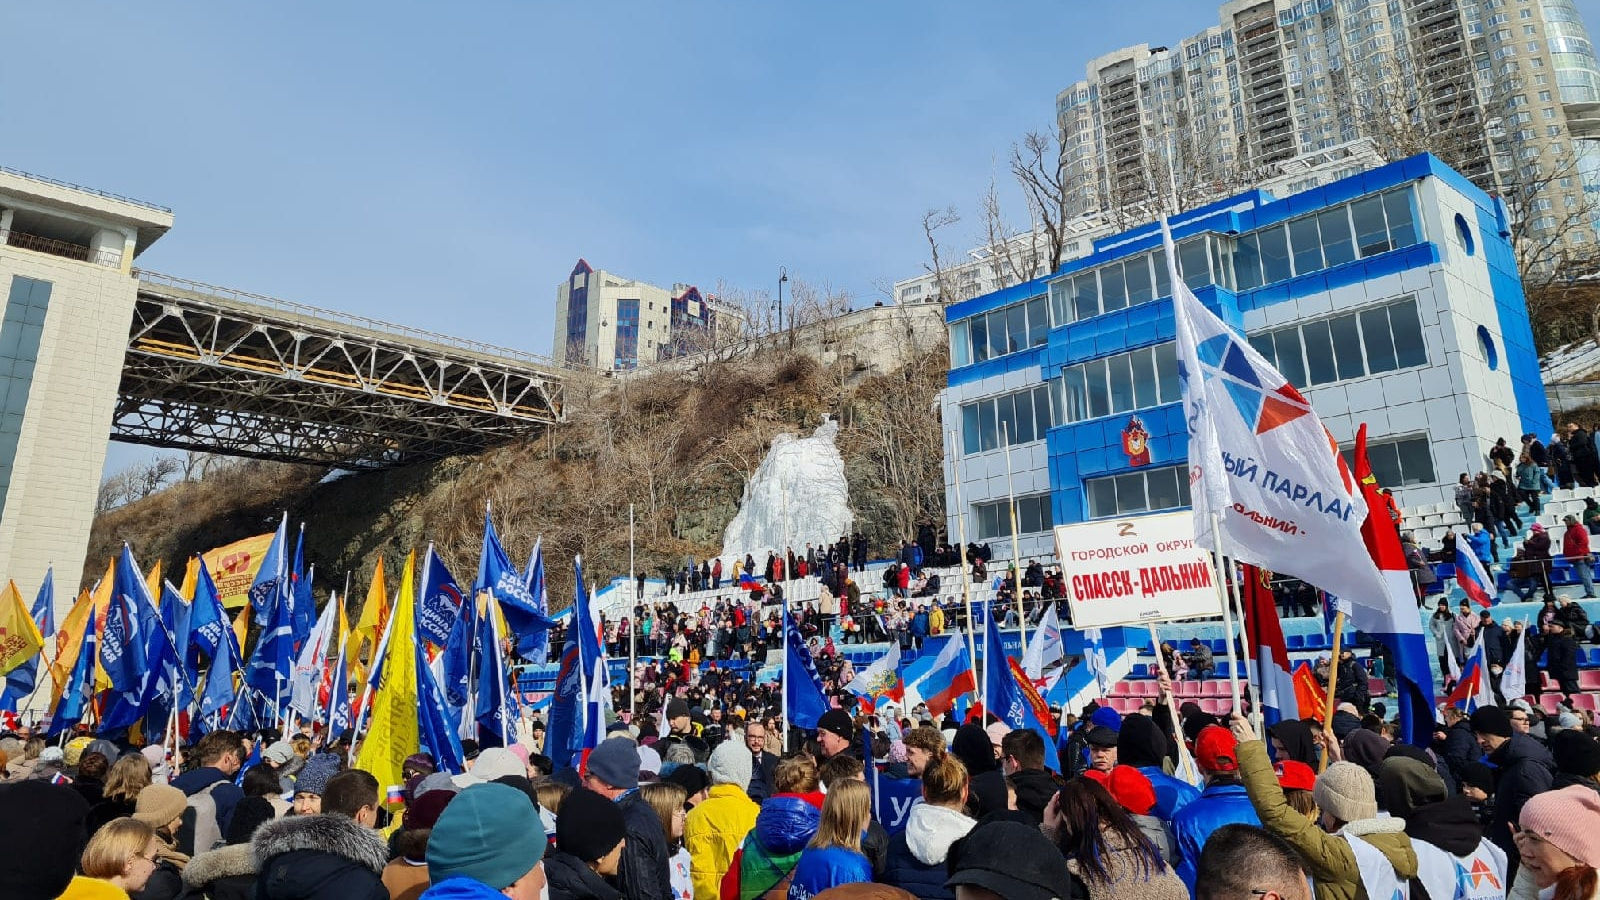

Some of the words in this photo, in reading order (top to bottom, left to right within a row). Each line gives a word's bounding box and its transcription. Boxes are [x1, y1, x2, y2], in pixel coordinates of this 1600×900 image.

[1229, 501, 1298, 536] альний
[1071, 542, 1149, 561] ГОРОДСКОЙ
[1156, 539, 1194, 553] ОКРУГ
